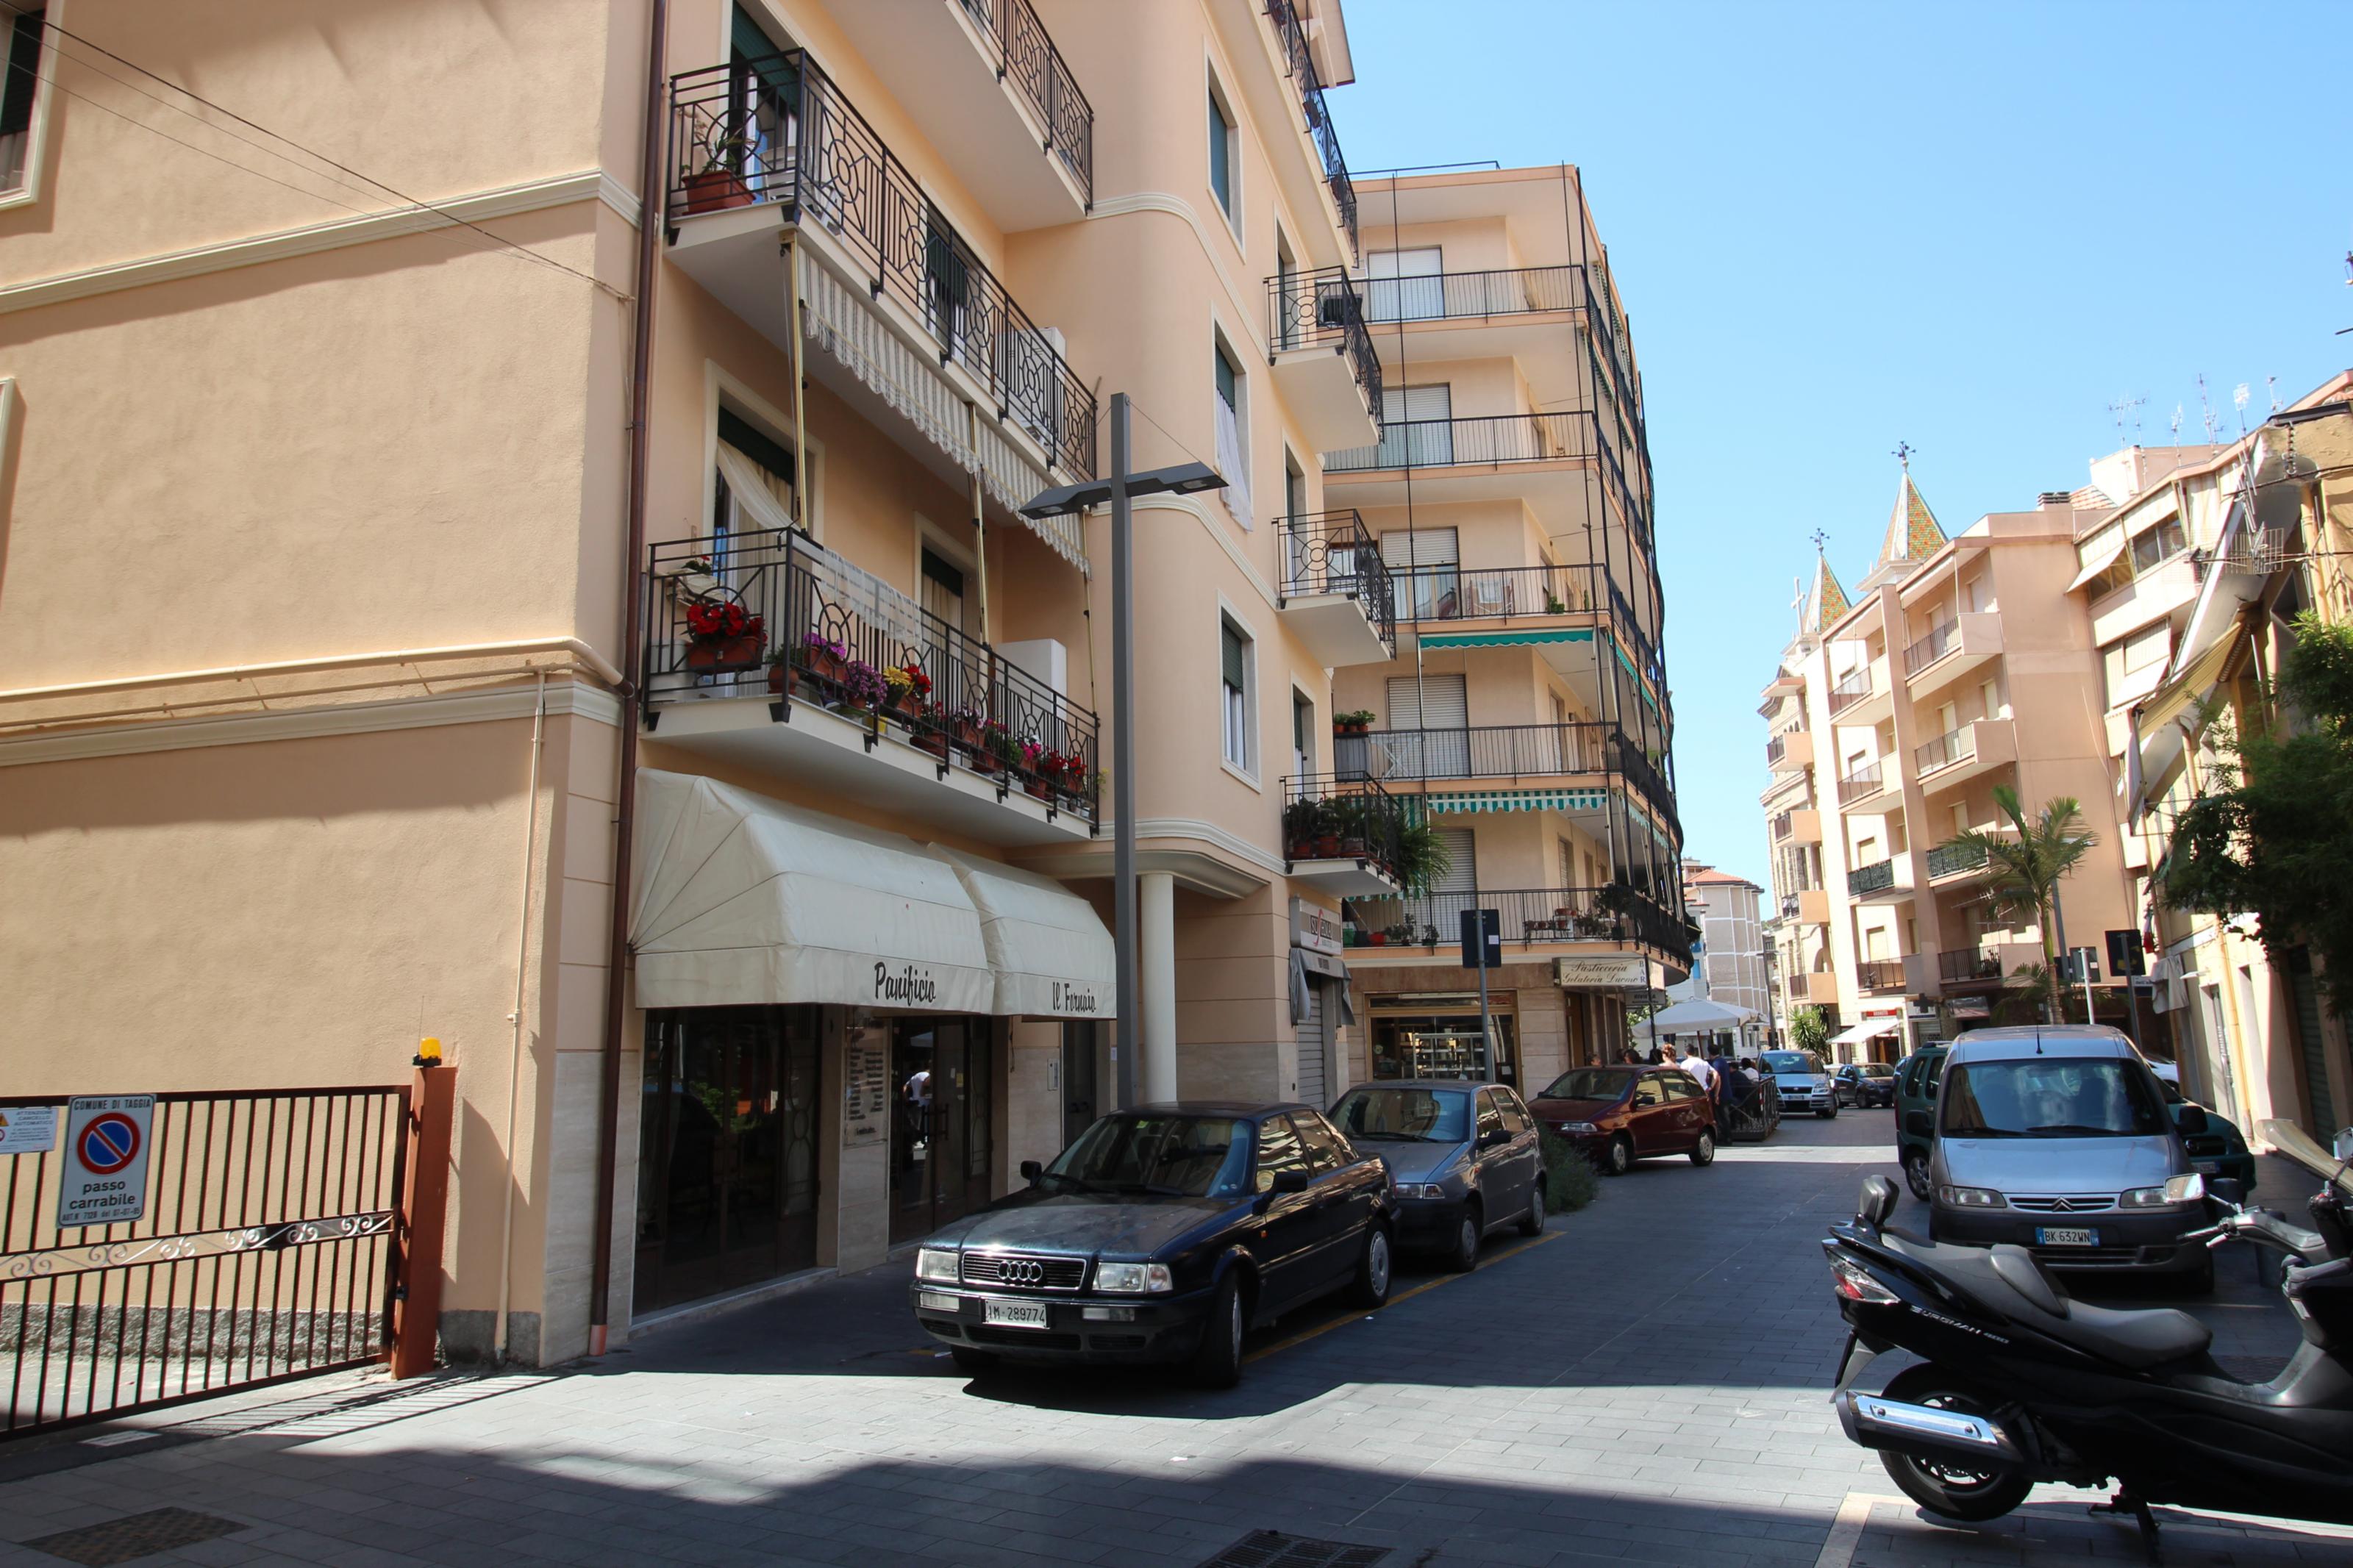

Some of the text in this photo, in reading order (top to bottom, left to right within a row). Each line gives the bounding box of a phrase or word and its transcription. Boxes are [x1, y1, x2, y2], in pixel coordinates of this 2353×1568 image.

[1571, 961, 1627, 973] Pasticceria
[874, 962, 936, 1006] Panificio
[1563, 973, 1638, 984] Gelateria Duomo
[1053, 982, 1096, 1012] Il Fornaio
[74, 1098, 151, 1110] COMUNE DI TAGGIA
[82, 1181, 126, 1195] passo
[70, 1193, 135, 1209] carrabile
[2044, 1231, 2090, 1242] BK 632WN
